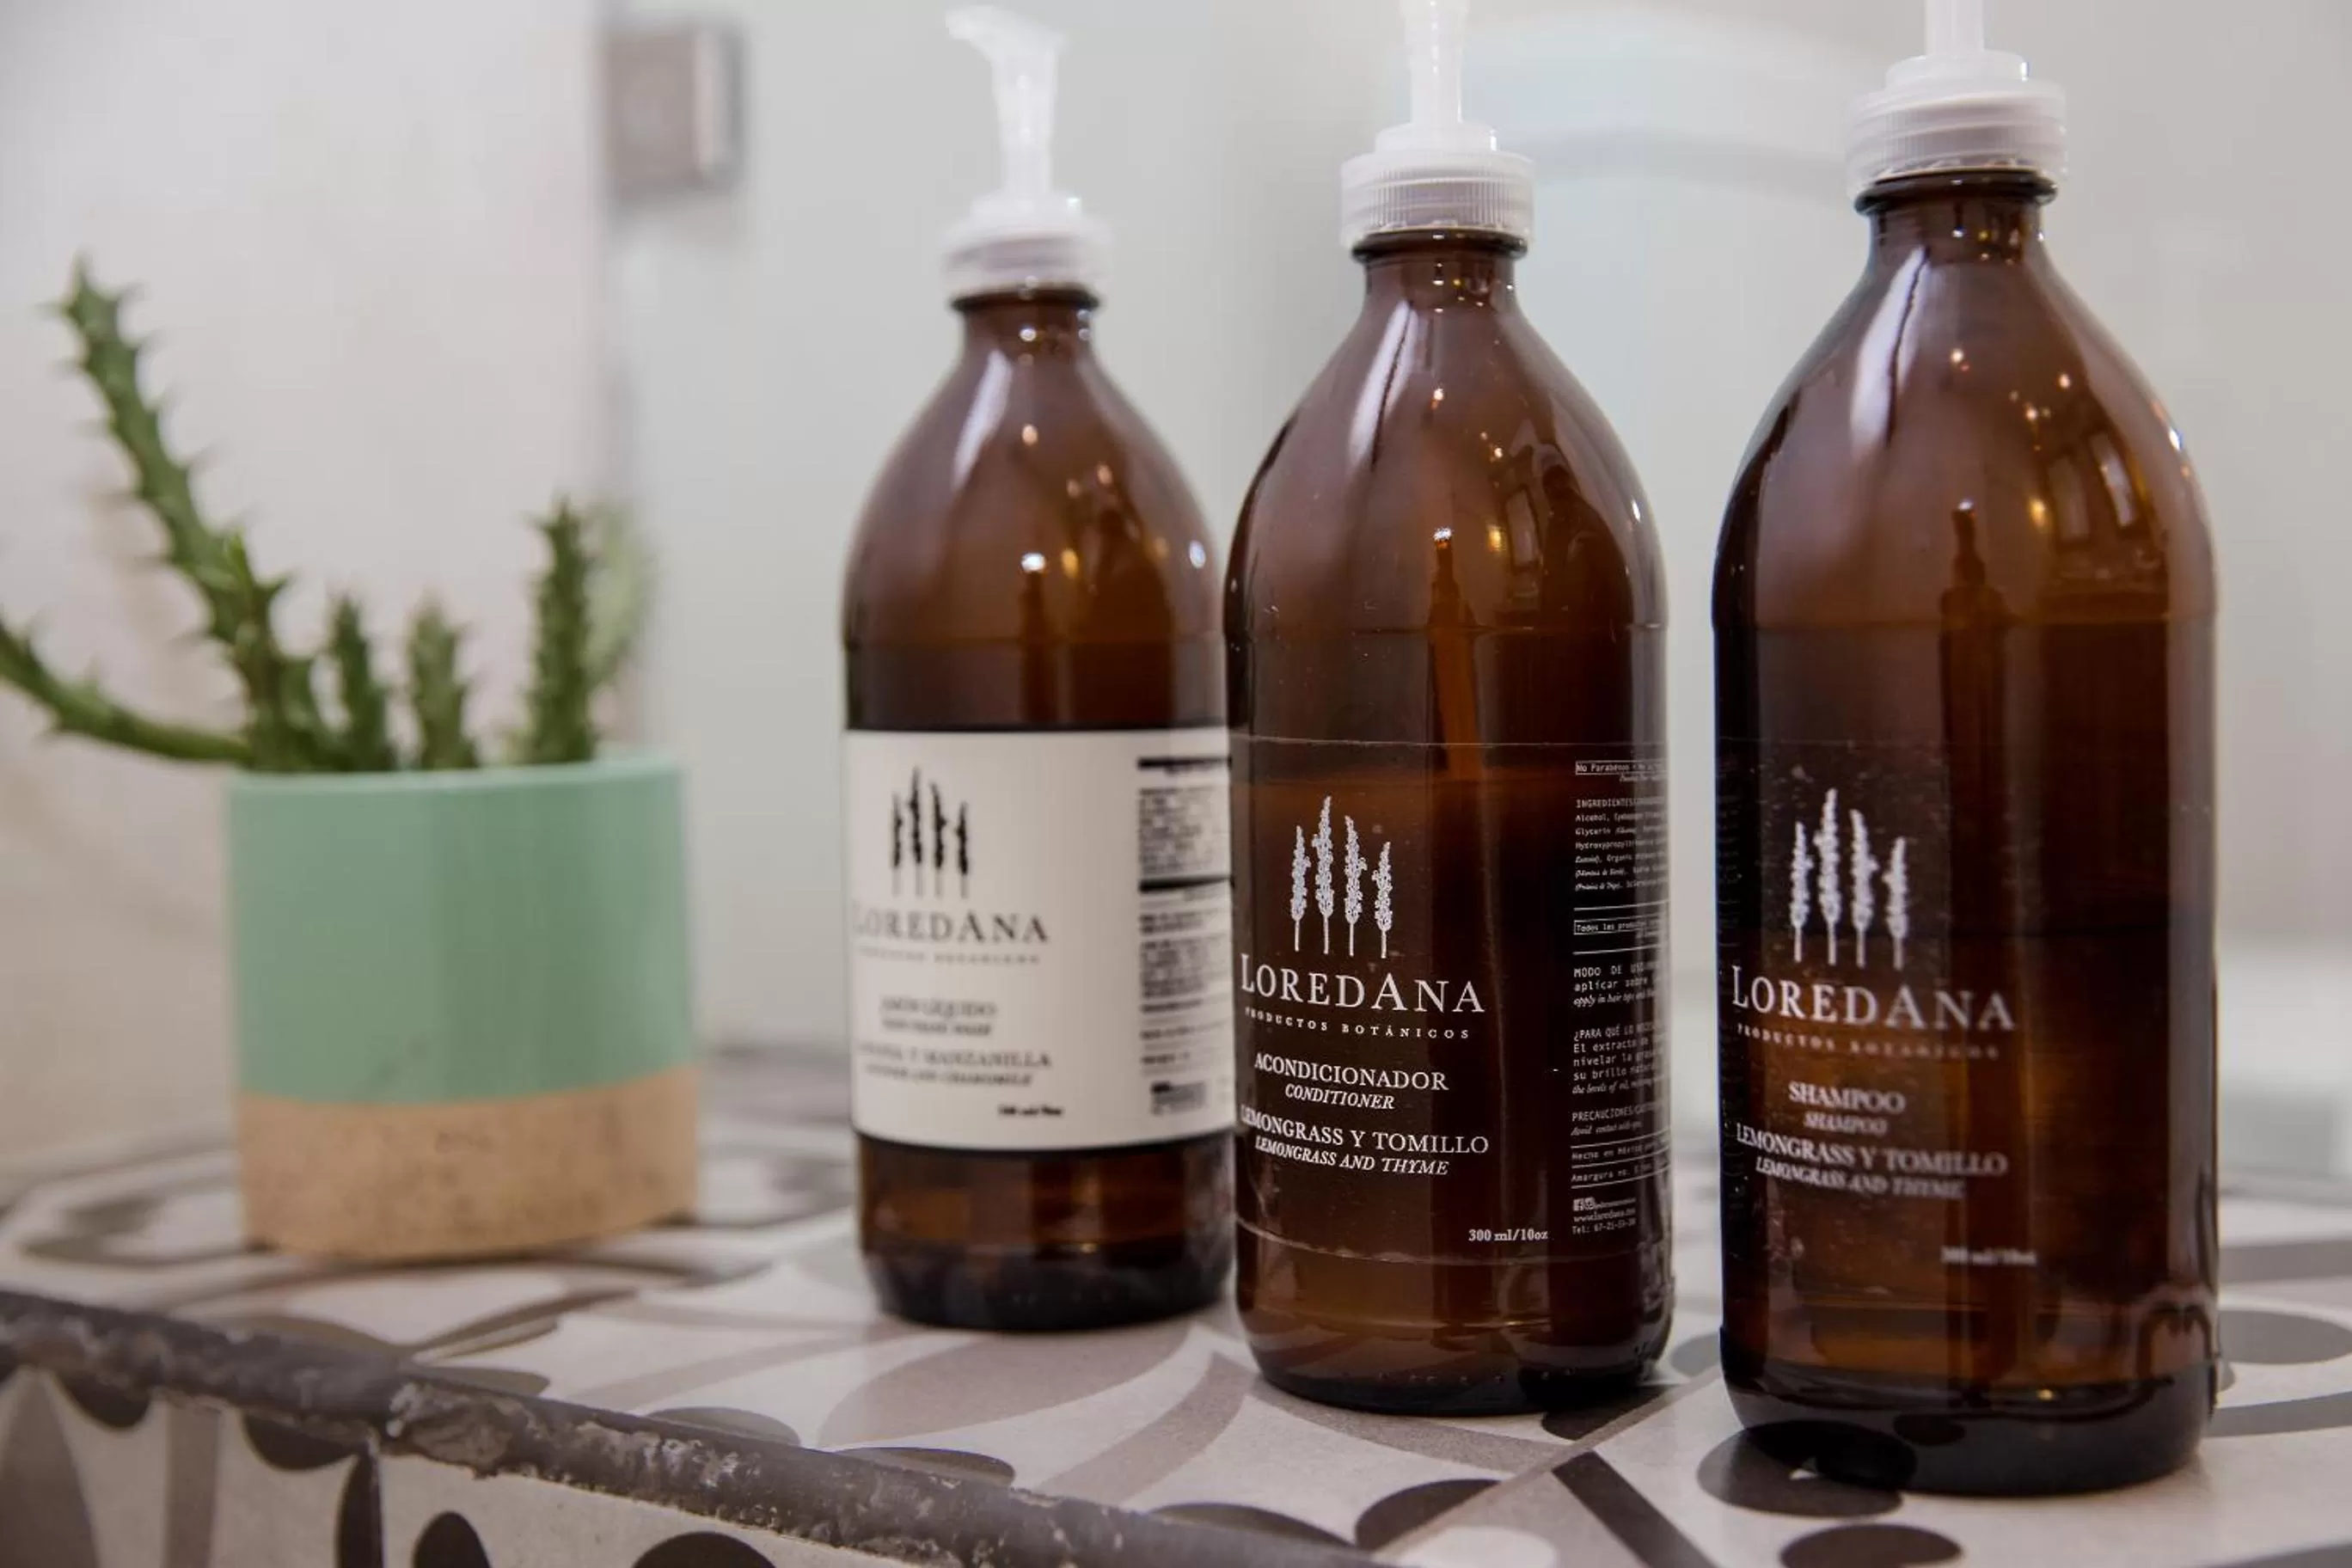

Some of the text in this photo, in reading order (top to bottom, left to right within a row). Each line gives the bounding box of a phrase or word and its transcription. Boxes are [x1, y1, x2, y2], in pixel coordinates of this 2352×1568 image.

[1240, 953, 1485, 1013] LOREDANA
[1574, 967, 1601, 977] MODO
[1611, 965, 1622, 975] DE
[1574, 980, 1617, 993] aplicar
[1732, 965, 2014, 1030] LOREDANA
[1245, 1007, 1328, 1031] PRODUCTOS
[1574, 1028, 1602, 1042] ¿PARA
[1574, 1044, 1586, 1053] El
[1574, 1054, 1616, 1067] nivelar
[1254, 1052, 1449, 1090] ACONDICIONADOR
[1573, 1072, 1587, 1081] su
[1592, 1067, 1626, 1080] brillo
[1285, 1083, 1395, 1109] CONDITIONER
[1789, 1081, 1906, 1114] SHAMPOO
[1240, 1105, 1489, 1154] LEMONGRASS Y TOMILLO
[1255, 1136, 1449, 1175] LEMONGRASS AND THYME
[1736, 1123, 2009, 1176] LEMONGRASS Y TOMILLO
[1468, 1229, 1491, 1241] 300
